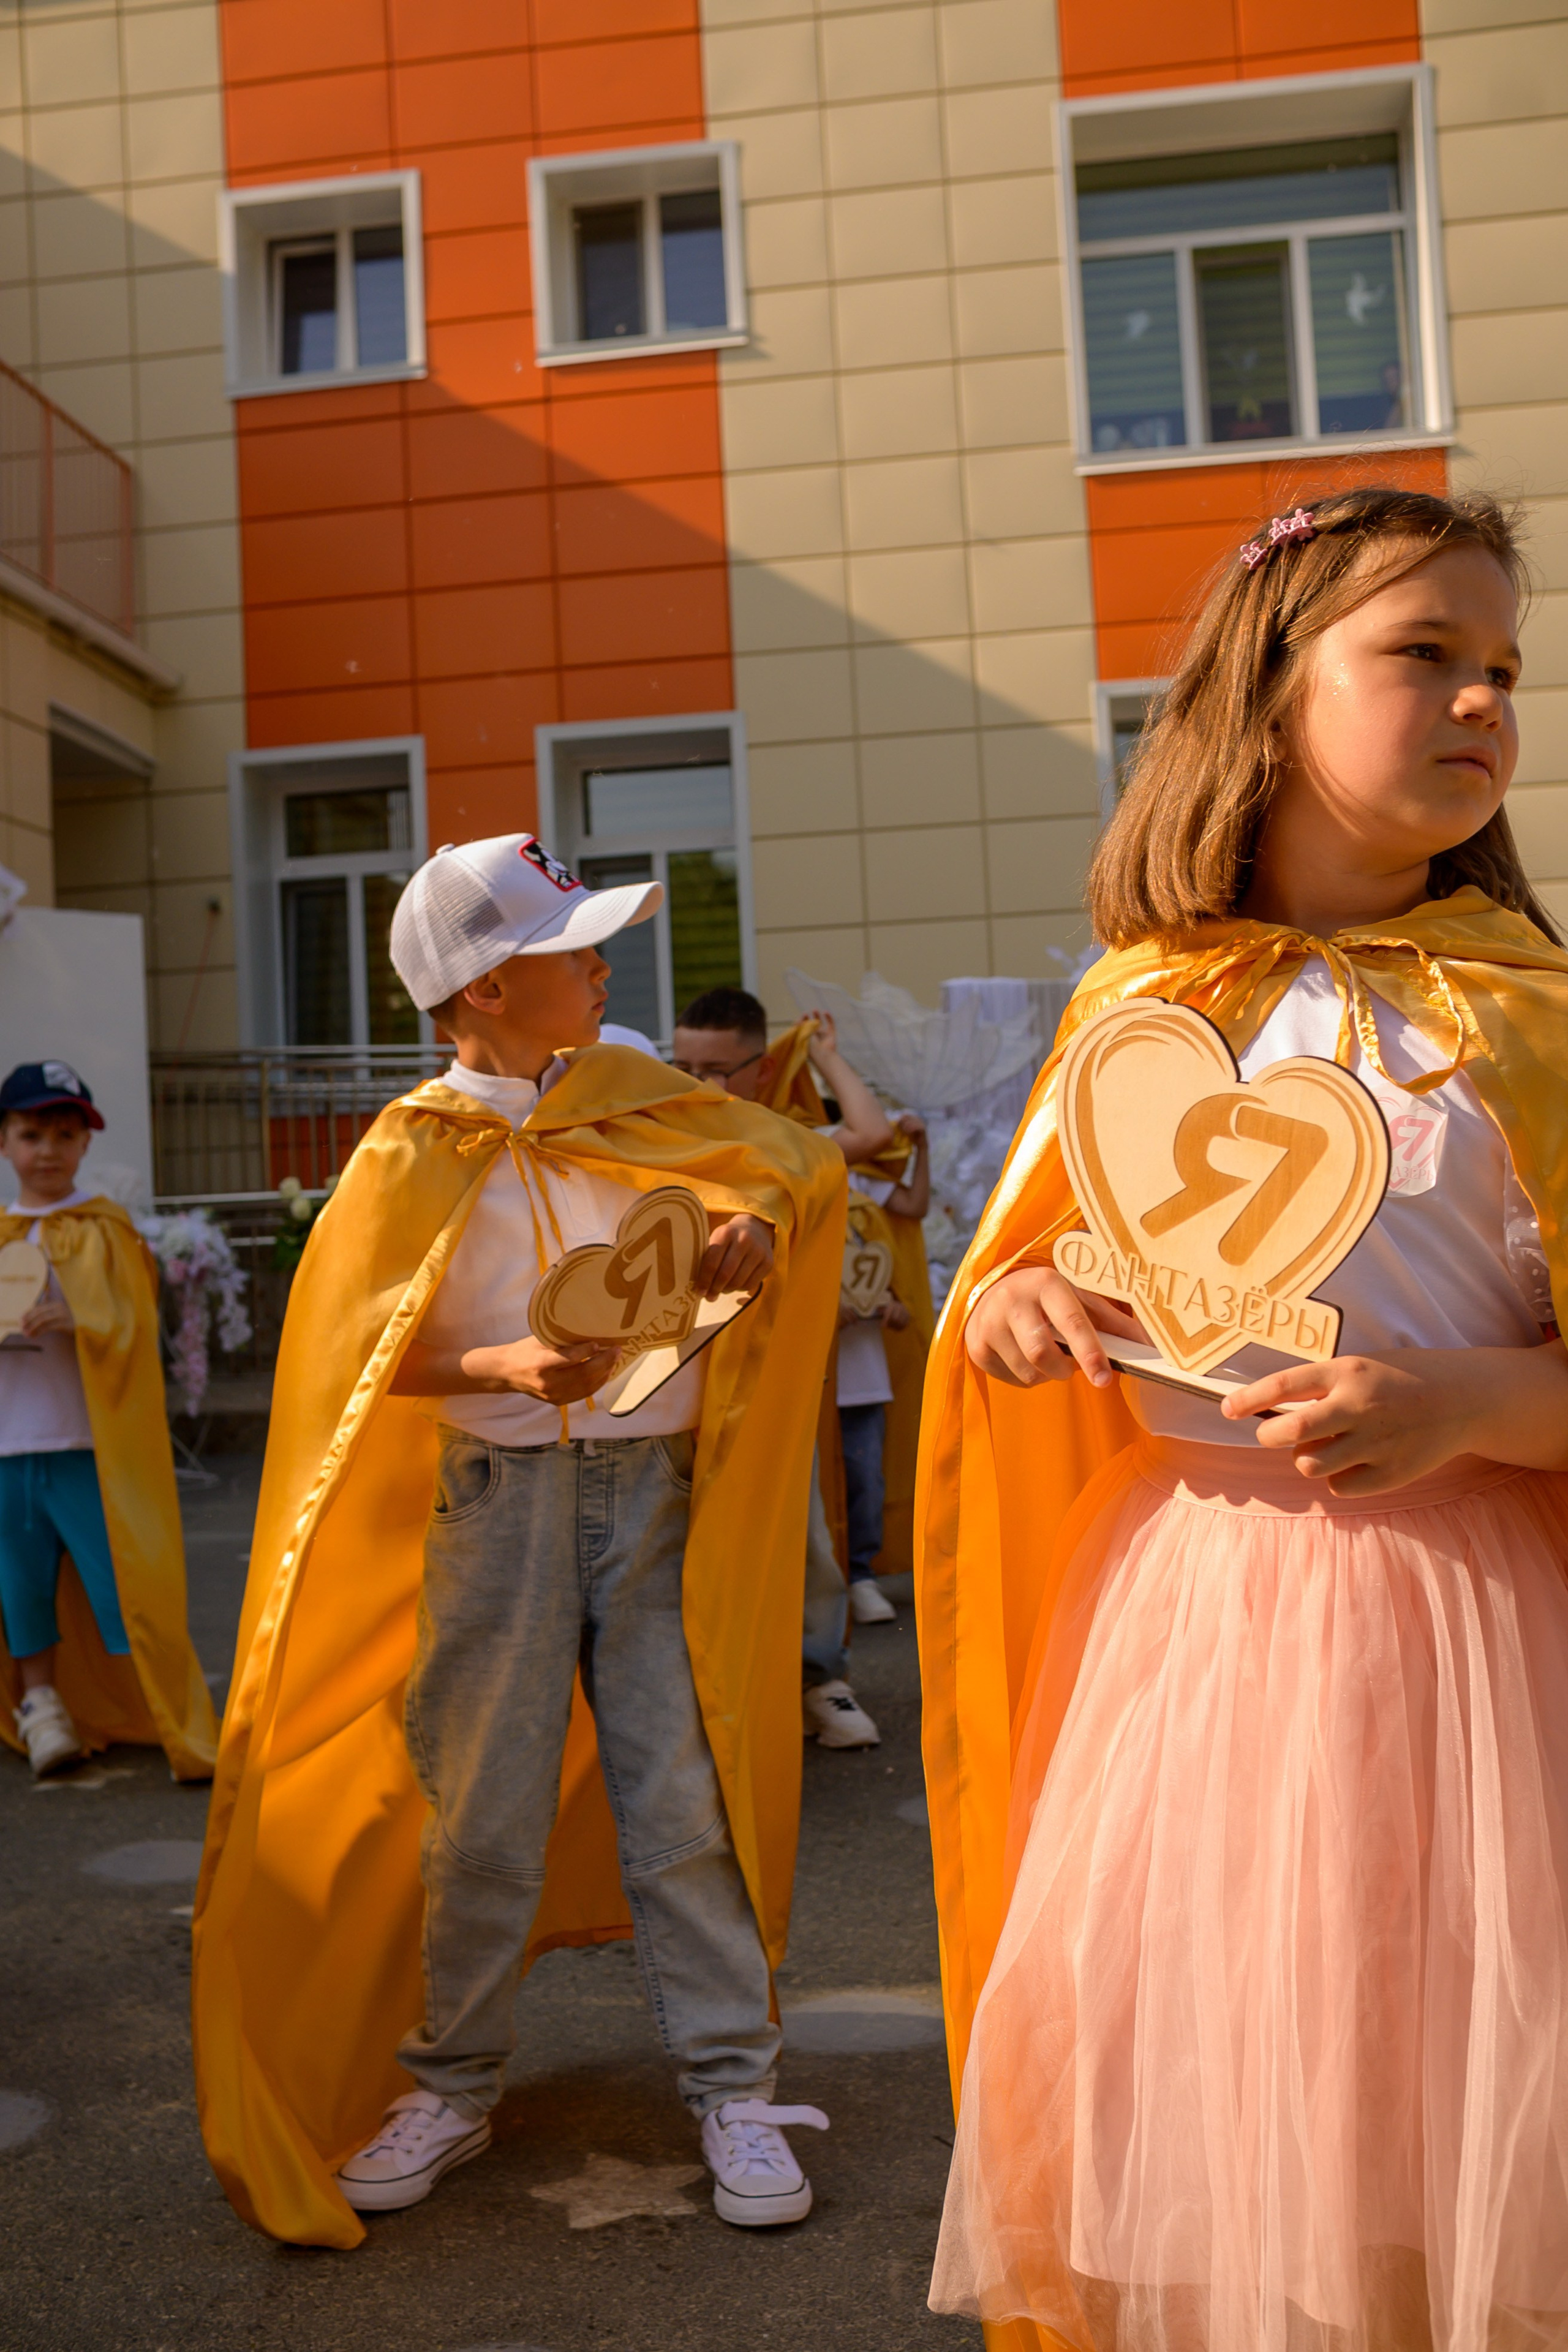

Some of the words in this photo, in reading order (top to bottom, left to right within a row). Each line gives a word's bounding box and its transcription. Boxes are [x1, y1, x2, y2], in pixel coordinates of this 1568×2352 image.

[1140, 1093, 1329, 1267] Я
[1389, 1115, 1434, 1161] Я
[605, 1217, 676, 1330] Я
[852, 1254, 880, 1288] Я
[1061, 1241, 1330, 1351] ФАНТАЗЁРЫ
